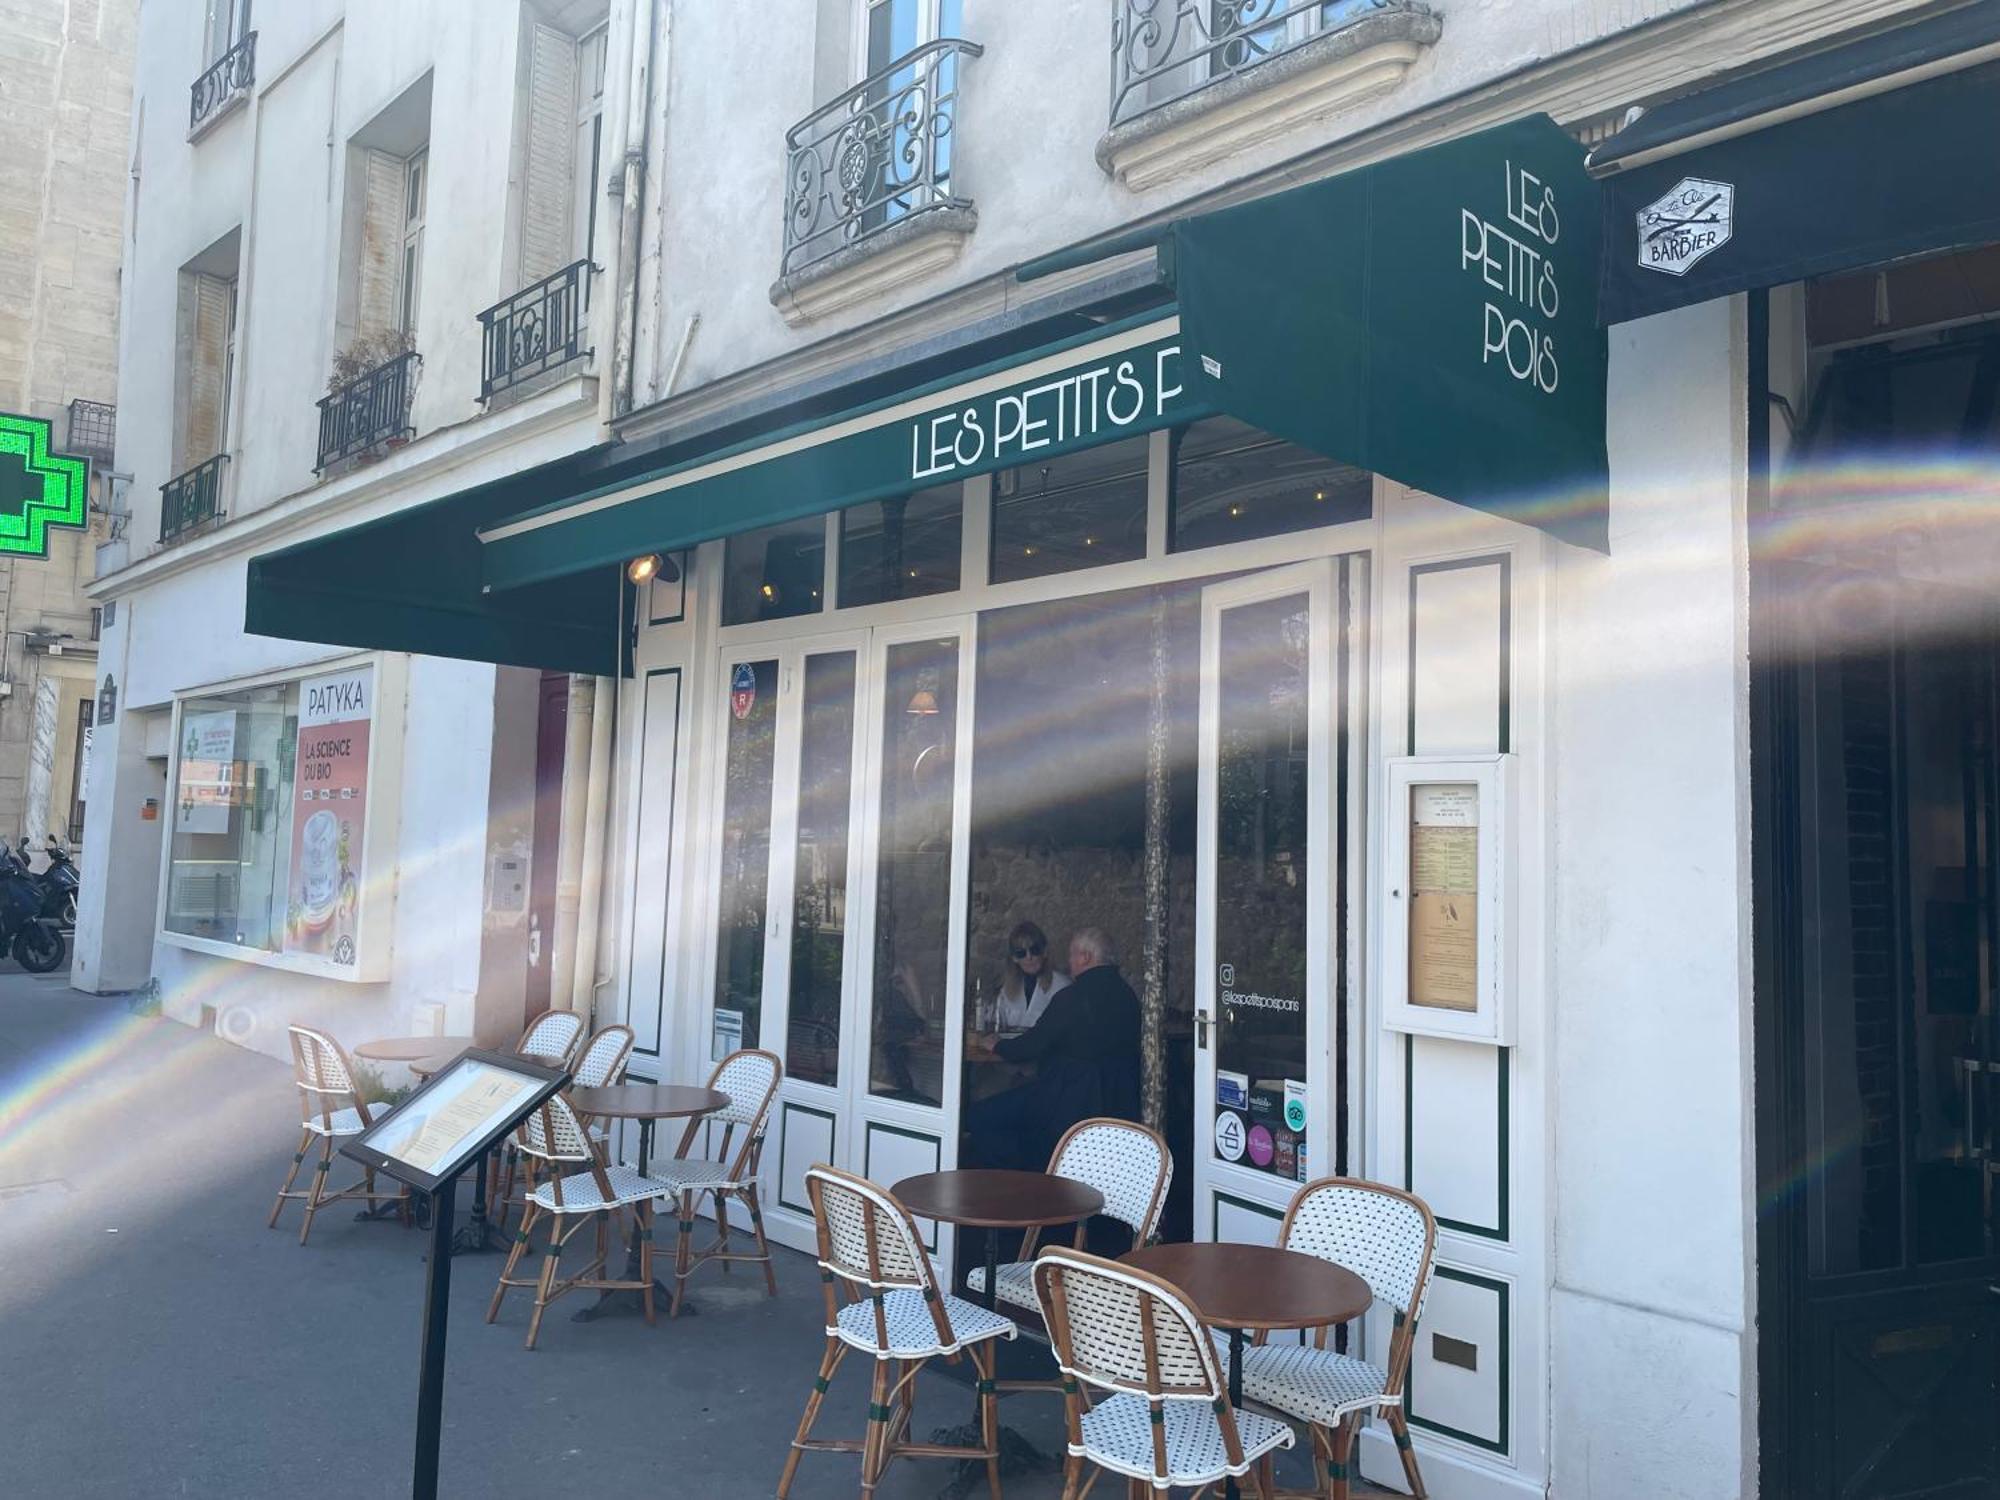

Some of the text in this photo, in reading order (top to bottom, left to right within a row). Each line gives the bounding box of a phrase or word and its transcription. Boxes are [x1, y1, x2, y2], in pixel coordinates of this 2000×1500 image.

[1506, 159, 1559, 244] LES
[1462, 208, 1559, 318] PETITS
[1651, 231, 1716, 262] BARBIER
[1483, 302, 1558, 393] POIS
[913, 408, 985, 479] LES
[994, 361, 1144, 458] PETITS
[308, 680, 364, 716] PATYKA
[304, 762, 332, 781] DU BIO
[305, 739, 352, 759] LA SCIENCE
